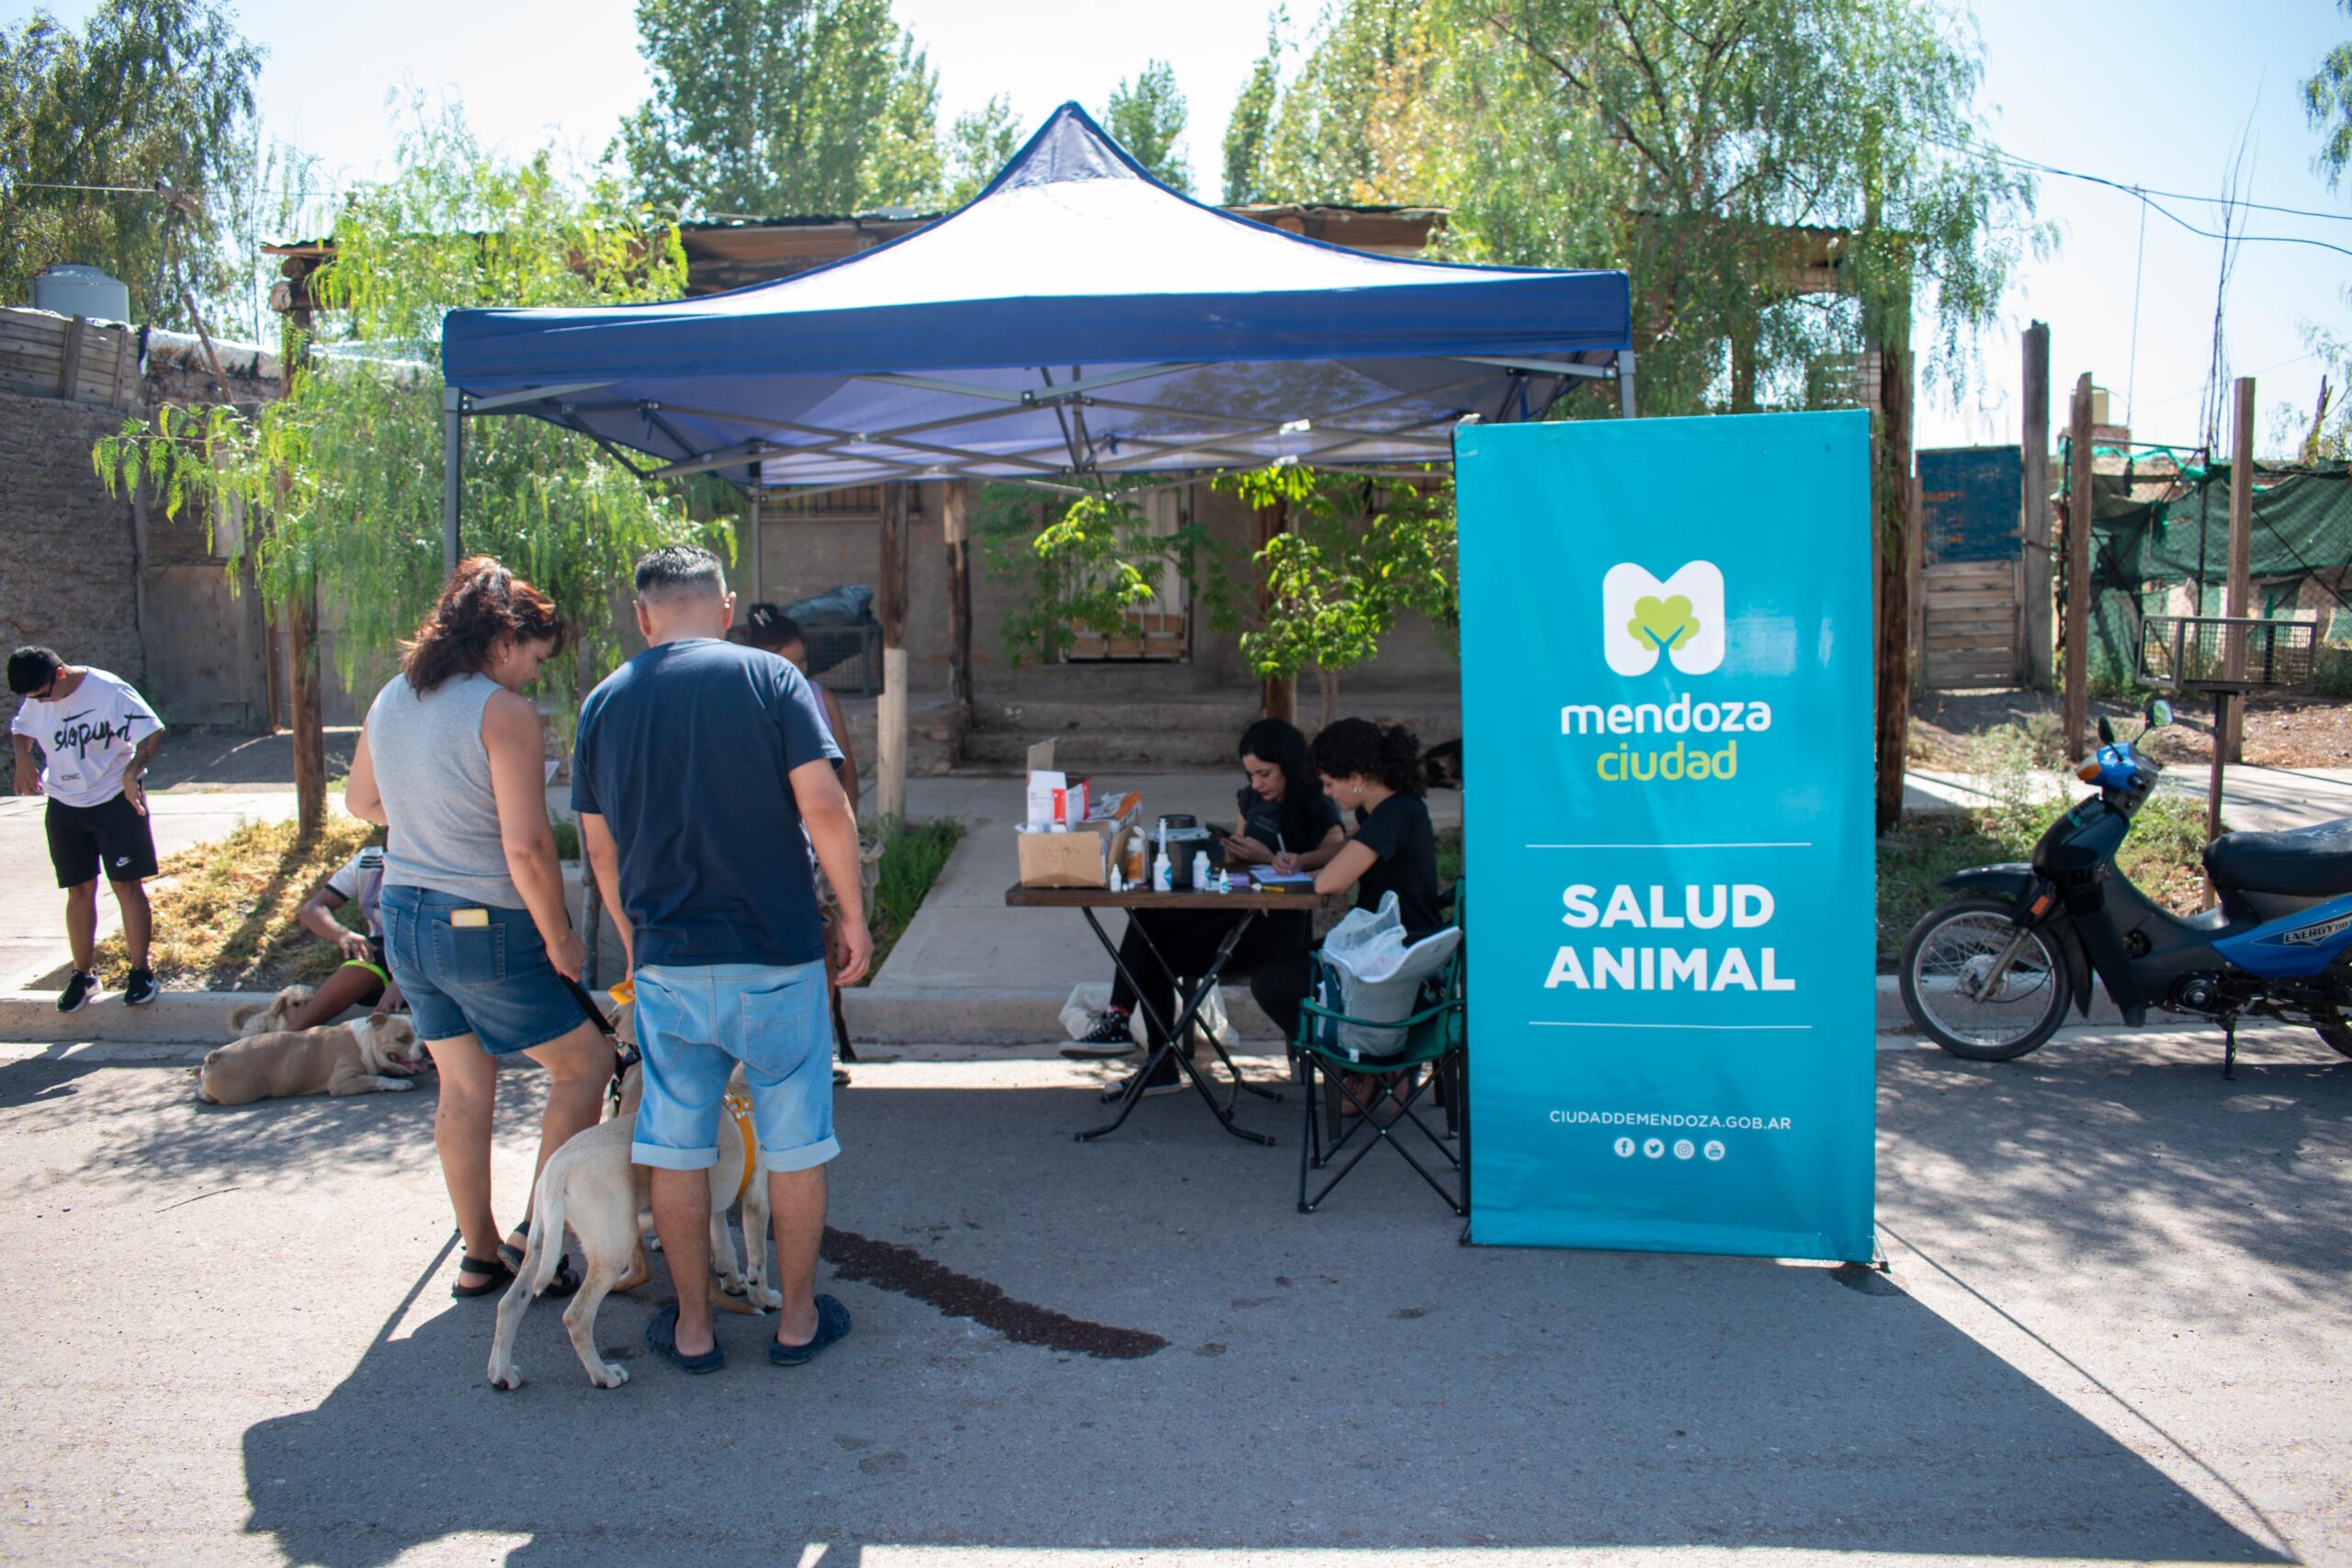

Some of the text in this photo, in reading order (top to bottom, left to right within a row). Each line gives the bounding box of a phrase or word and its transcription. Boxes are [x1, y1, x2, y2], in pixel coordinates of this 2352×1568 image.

[1561, 692, 1772, 735] mendoza
[1597, 739, 1737, 782] ciudad
[1562, 884, 1775, 930] SALUD
[2285, 925, 2332, 942] ENERGY
[1544, 945, 1796, 992] ANIMAL
[1550, 1110, 1792, 1130] CIUDADDEMENDOZA.GOB.AR
